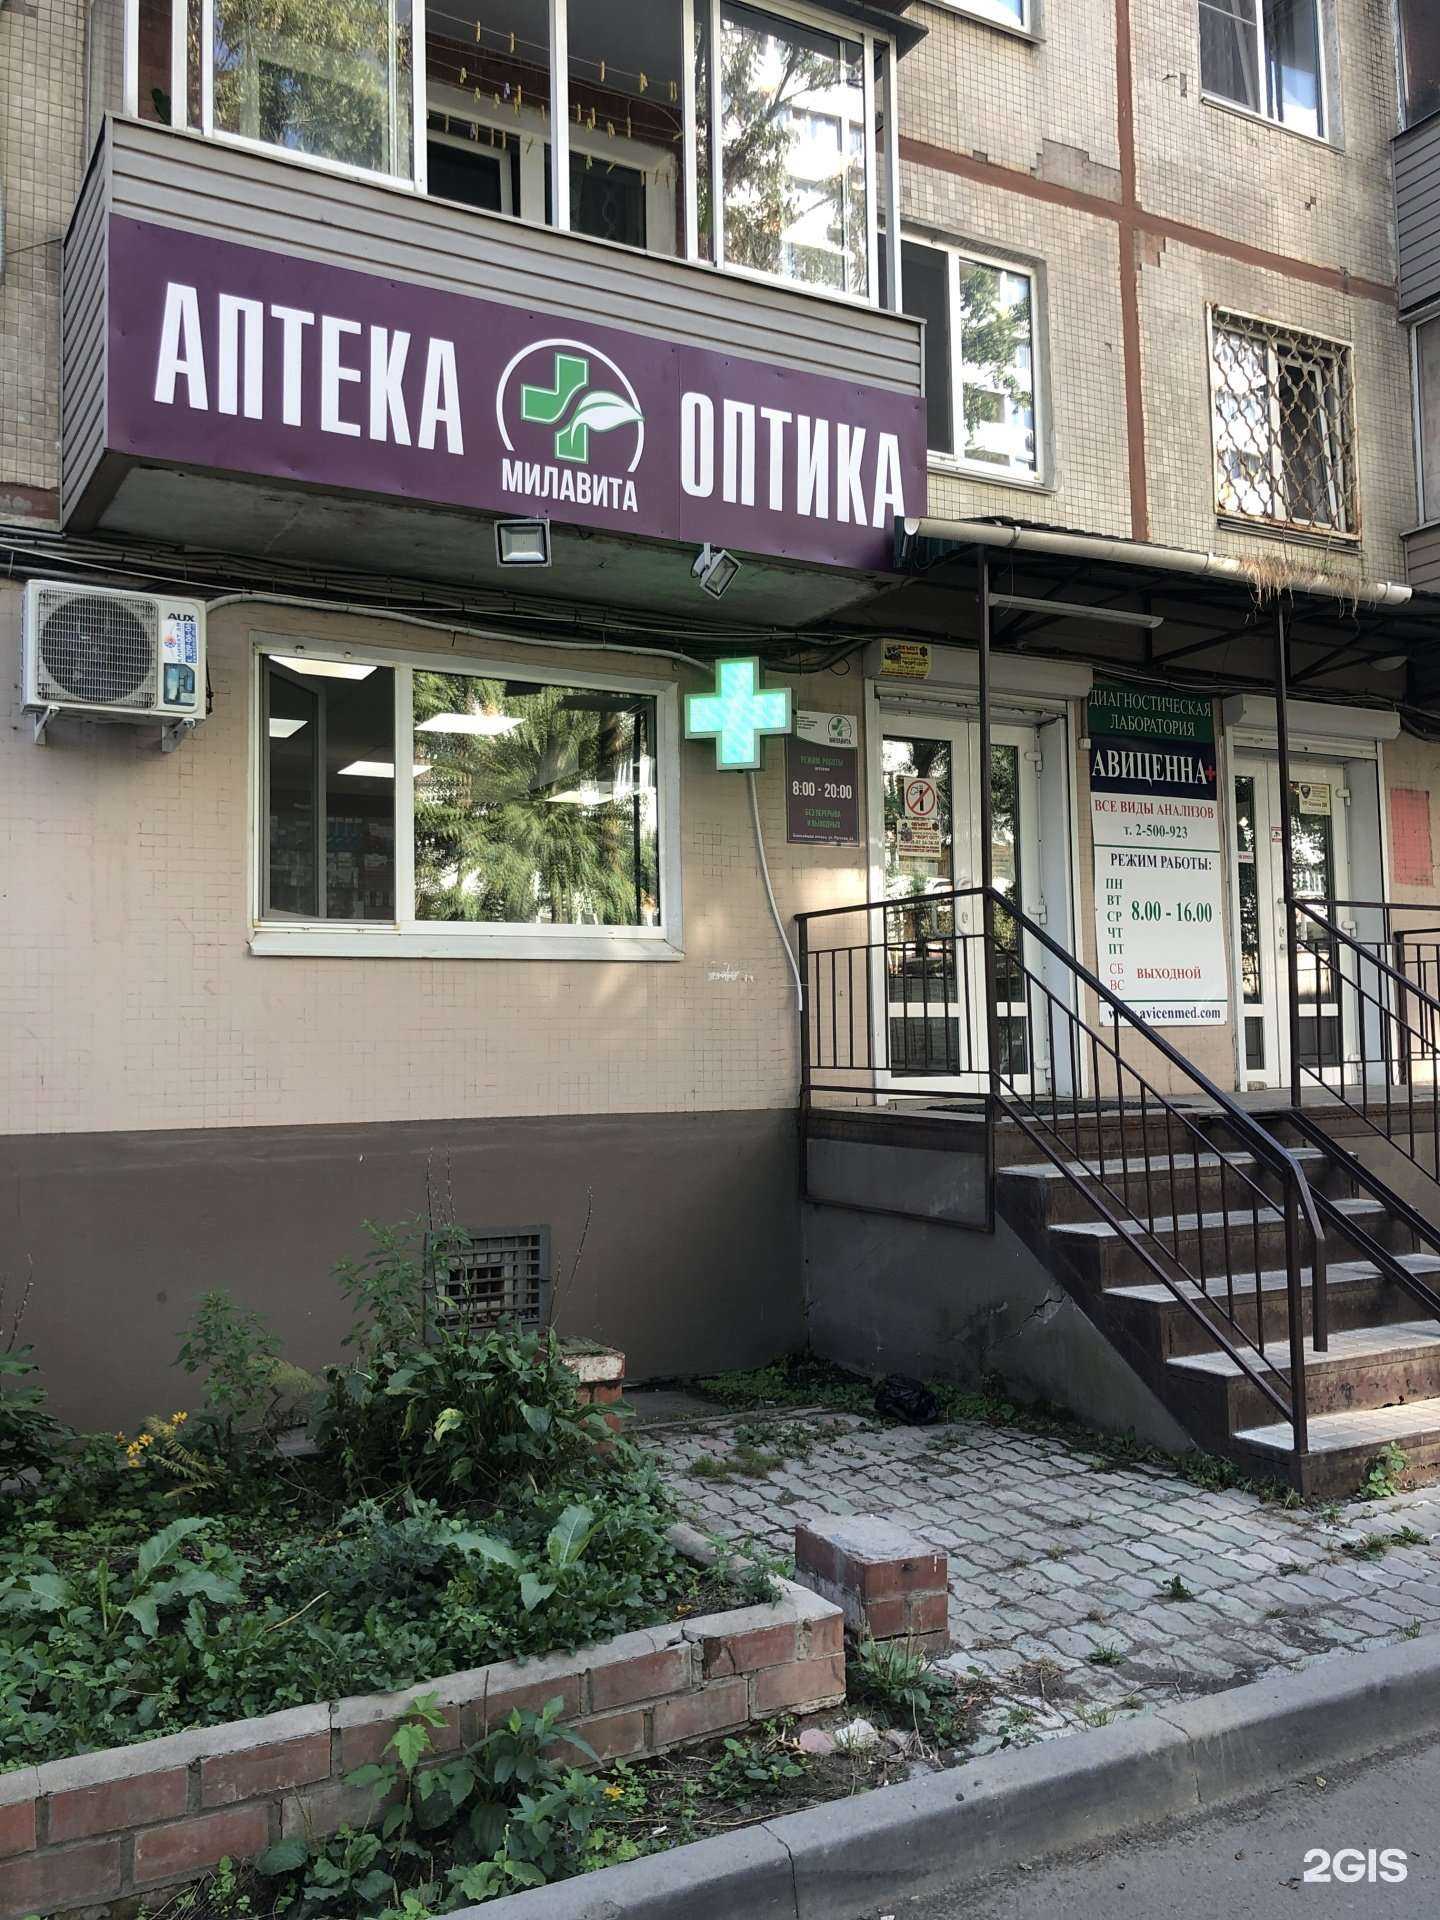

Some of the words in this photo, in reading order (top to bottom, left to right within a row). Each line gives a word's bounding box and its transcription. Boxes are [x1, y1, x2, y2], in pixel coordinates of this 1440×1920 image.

[154, 281, 464, 456] АПТЕКА
[680, 391, 906, 529] ОПТИКА
[502, 457, 639, 513] МИЛАВИТА
[168, 613, 195, 622] AUX
[1089, 689, 1211, 717] ДИАГНОСТИЧЕСКАЯ
[1110, 714, 1195, 736] ЛАБОРАТОРИЯ
[792, 781, 815, 796] 8:00
[824, 783, 852, 799] 20:00
[1095, 800, 1117, 812] ВСЕ
[1120, 801, 1153, 816] ВИДЫ
[1157, 803, 1214, 819] АНАЛИЗОВ
[1123, 826, 1132, 836] т.
[1135, 823, 1188, 839] 2-500-923
[1111, 853, 1157, 868] РЕЖИМ
[1160, 855, 1213, 870] РАБОТЫ:
[1106, 878, 1123, 890] ПН
[1107, 895, 1121, 906] ВТ
[1107, 911, 1122, 922] СР
[1131, 900, 1161, 921] 8.00
[1177, 902, 1212, 923] 16.00
[1108, 927, 1123, 938] ЧТ
[1109, 943, 1124, 955] ПТ
[1110, 963, 1124, 975] СБ
[1136, 965, 1201, 981] ВЫХОДНОЙ
[1110, 979, 1125, 991] ВС
